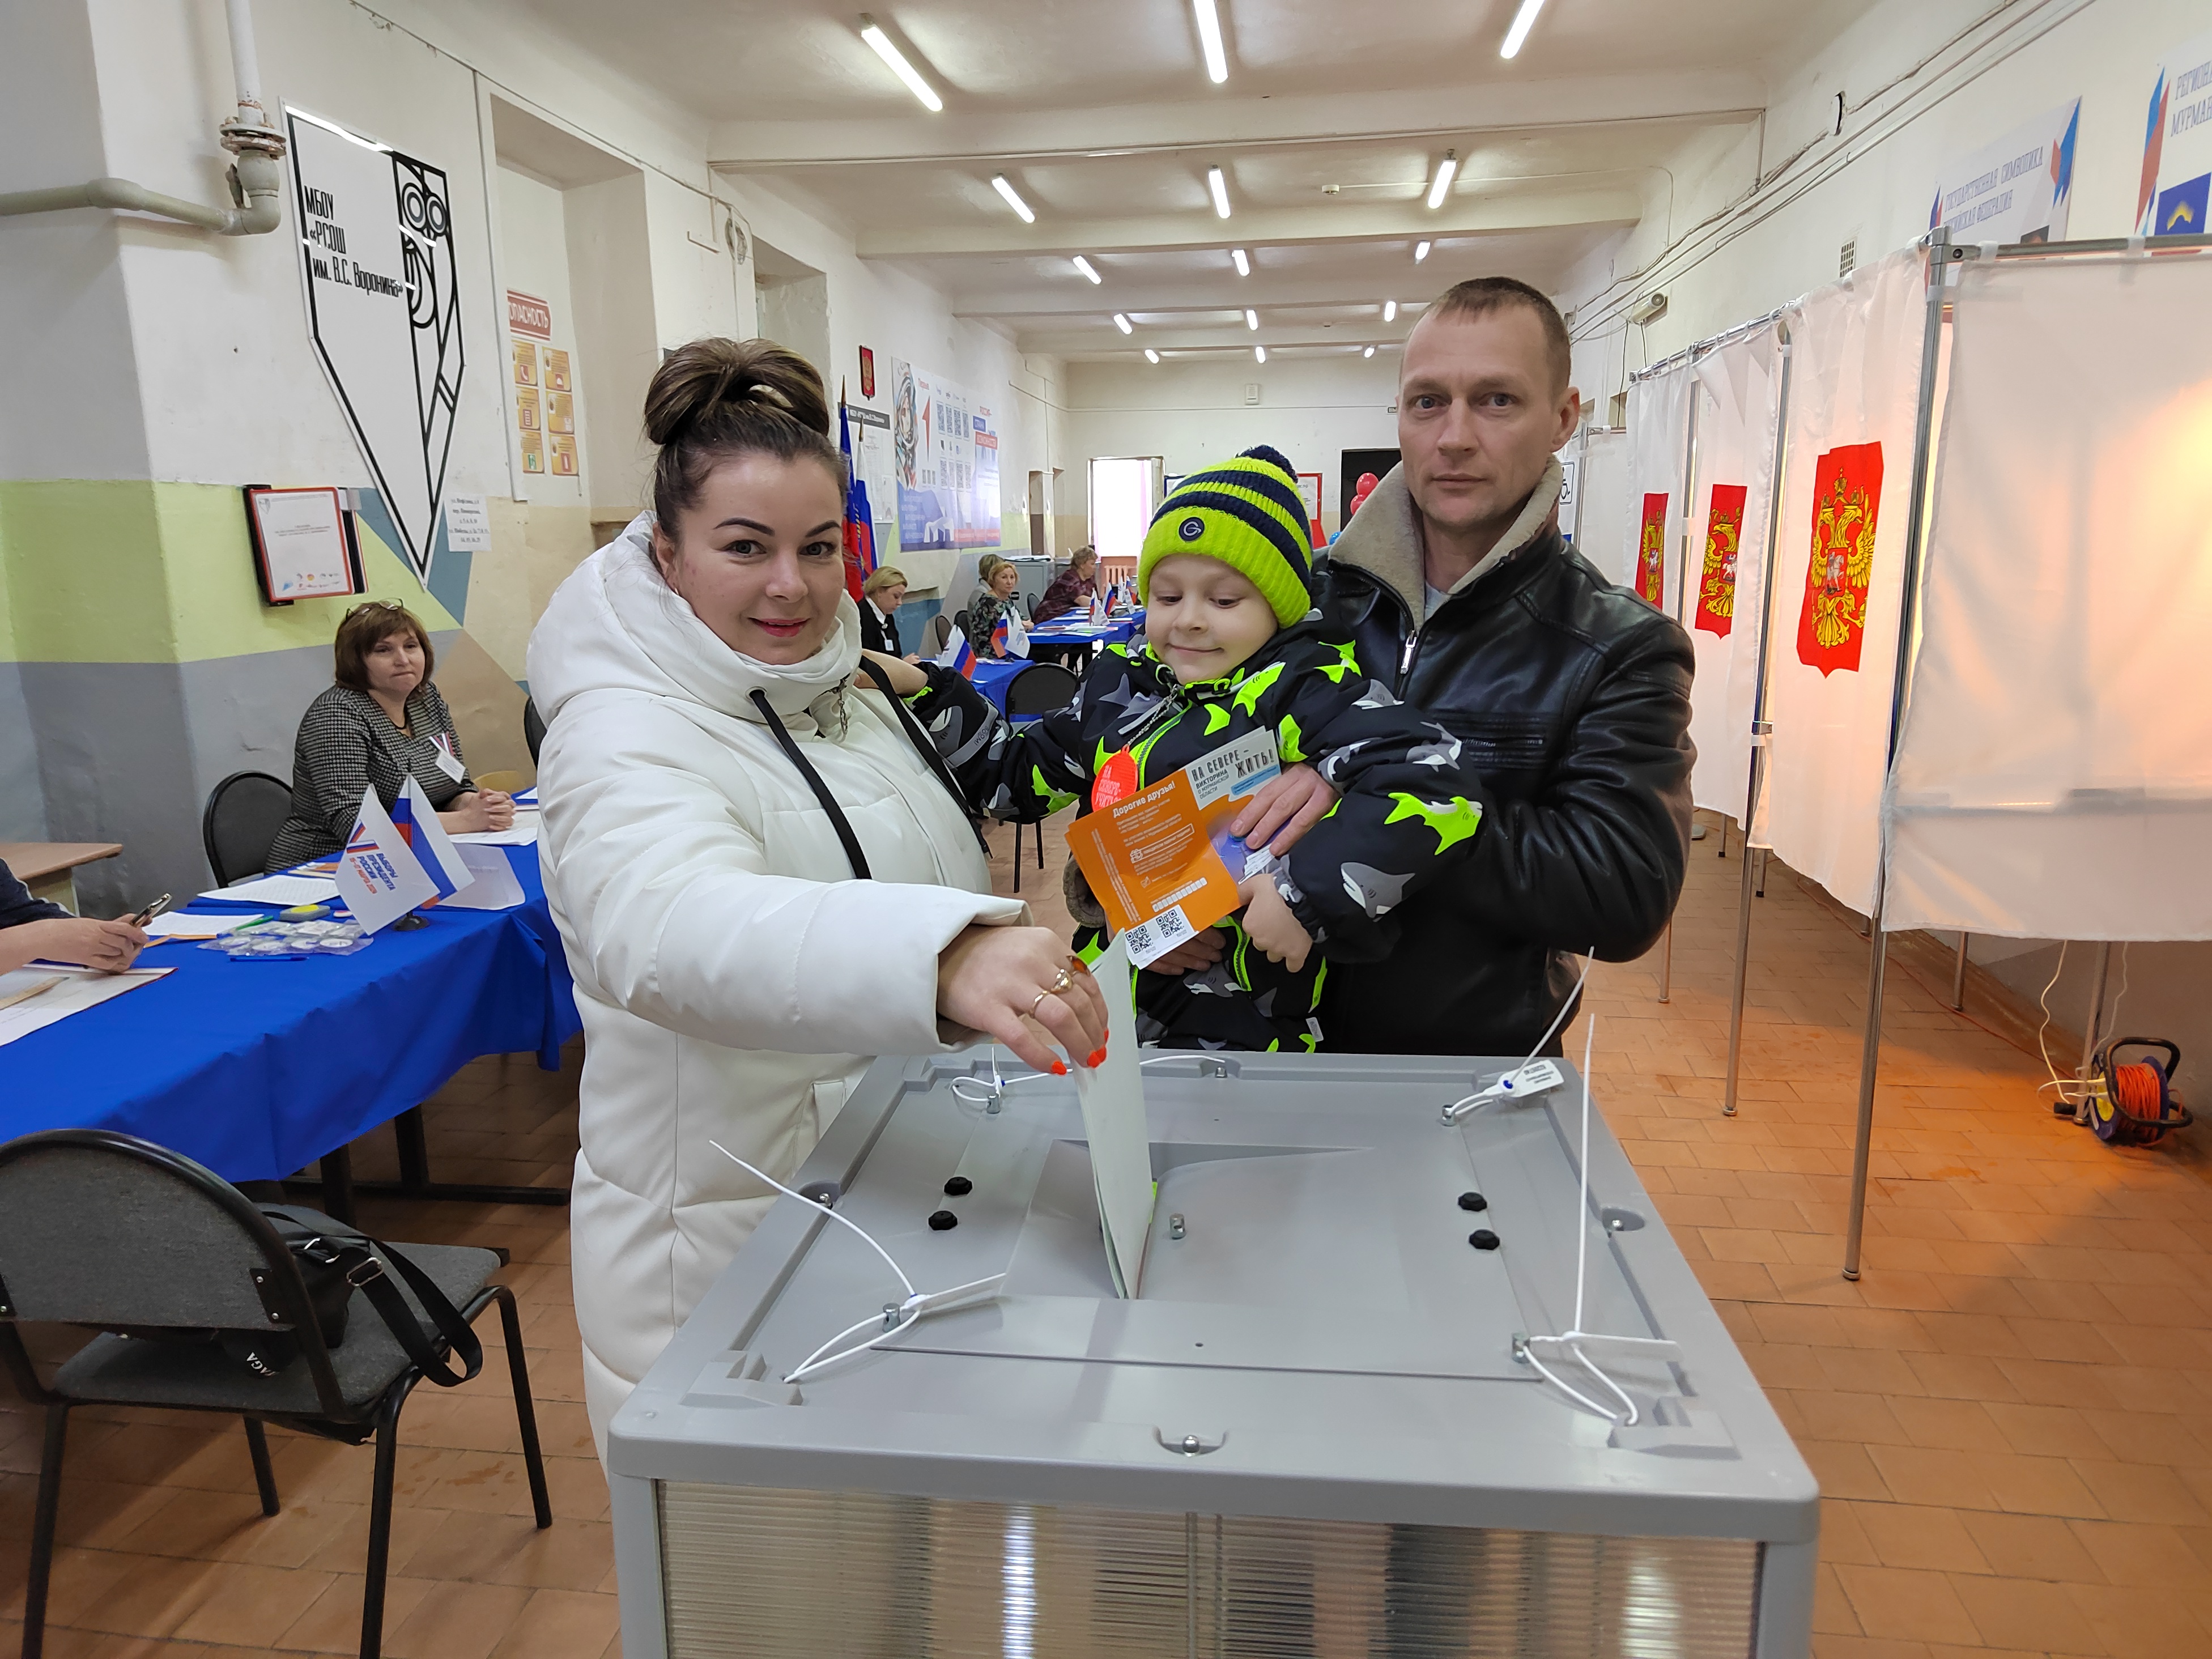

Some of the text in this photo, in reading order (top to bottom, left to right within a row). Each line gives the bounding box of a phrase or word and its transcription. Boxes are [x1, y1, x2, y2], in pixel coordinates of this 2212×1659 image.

[304, 185, 334, 220] МБОУ
[310, 220, 346, 254] «РСОШ
[312, 258, 331, 280] им.
[332, 256, 352, 286] В.С.
[1103, 765, 1112, 779] НА
[1192, 767, 1205, 782] НА
[1206, 750, 1240, 773] СЕВЕРЕ
[1235, 748, 1275, 779] ЖИТЬ!
[1196, 769, 1228, 789] ВИКТОРИНА
[1113, 797, 1146, 818] Дорогие
[1147, 780, 1176, 803] друзья!
[356, 856, 378, 879] РОССИИ
[376, 853, 399, 878] ВЫБОРЫ
